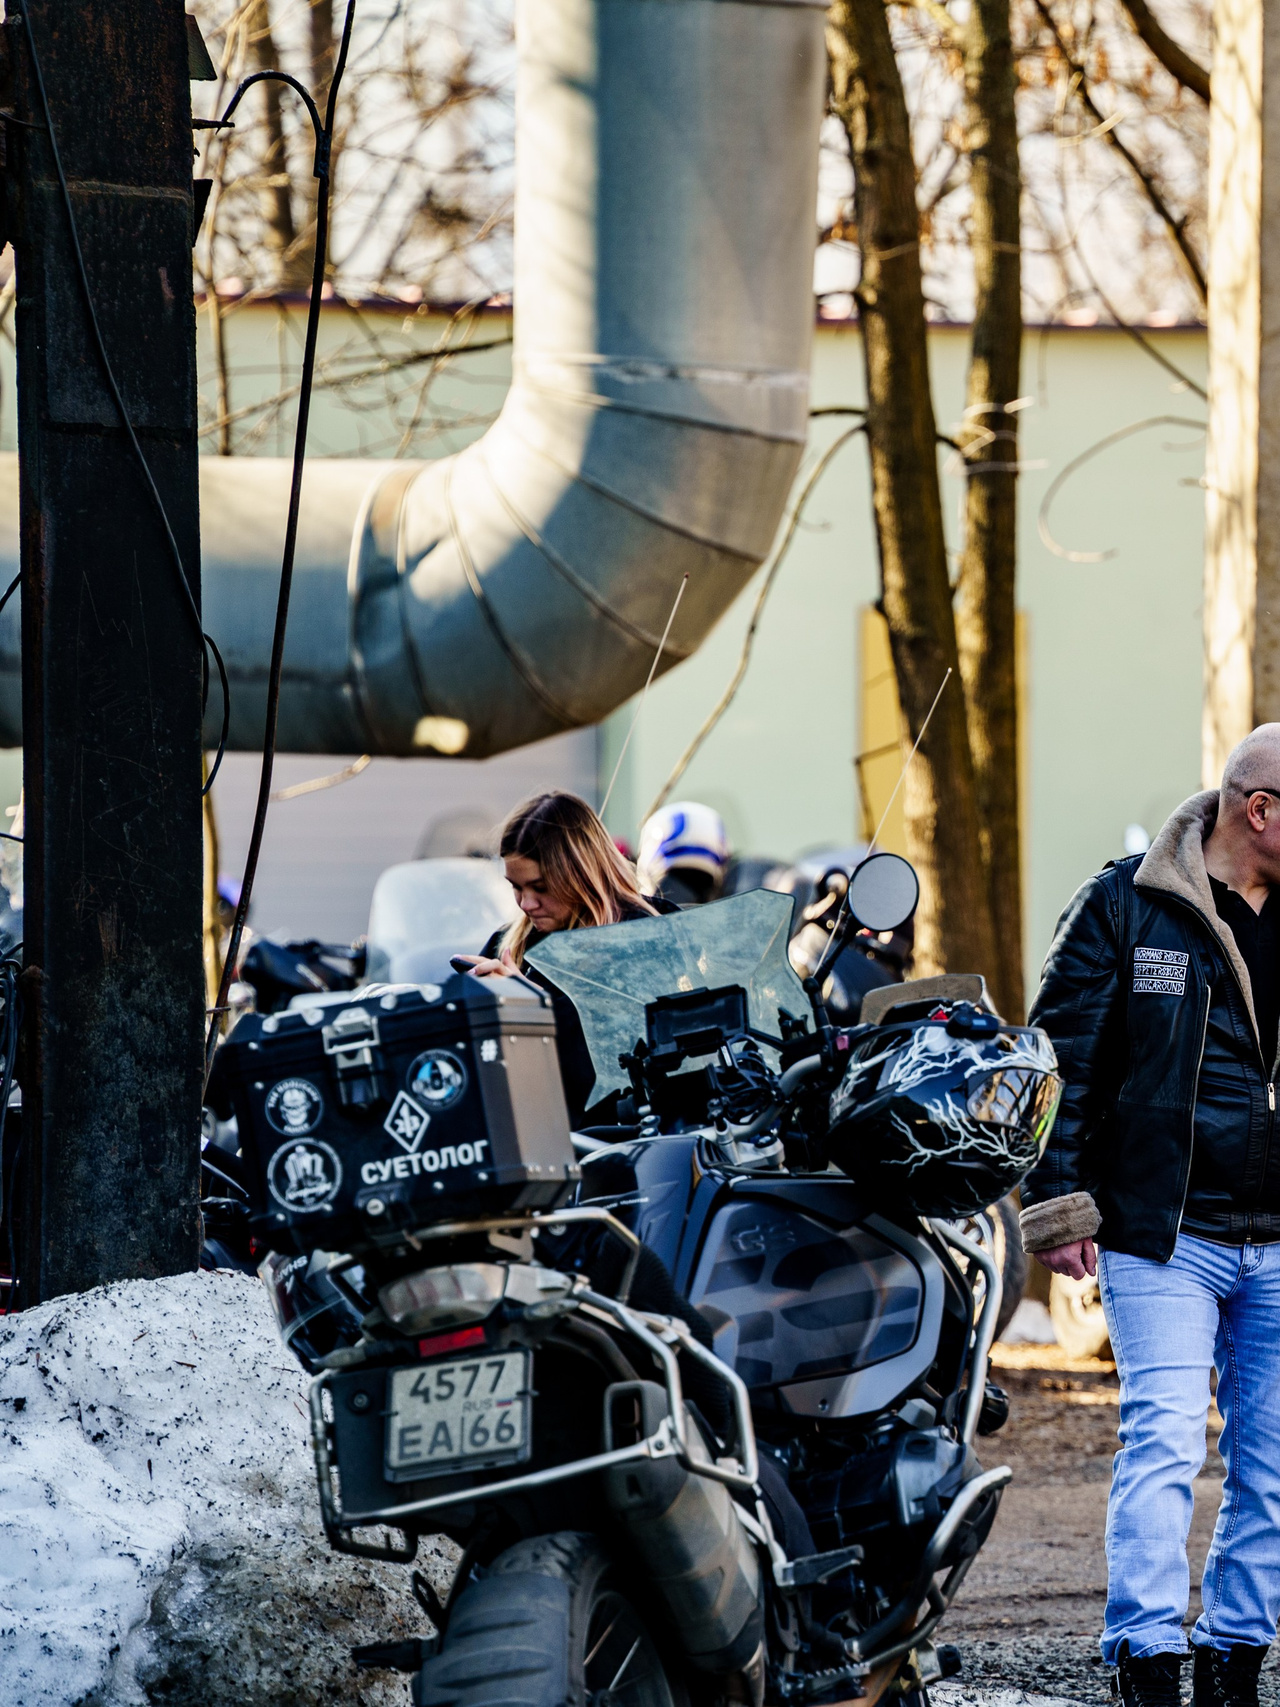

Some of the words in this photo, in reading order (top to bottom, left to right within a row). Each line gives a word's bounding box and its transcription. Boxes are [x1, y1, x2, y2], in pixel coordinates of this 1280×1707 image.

[361, 1140, 488, 1185] СУЕТОЛОГ
[408, 1360, 506, 1405] 4577
[462, 1397, 493, 1413] RUS
[468, 1409, 516, 1448] 66
